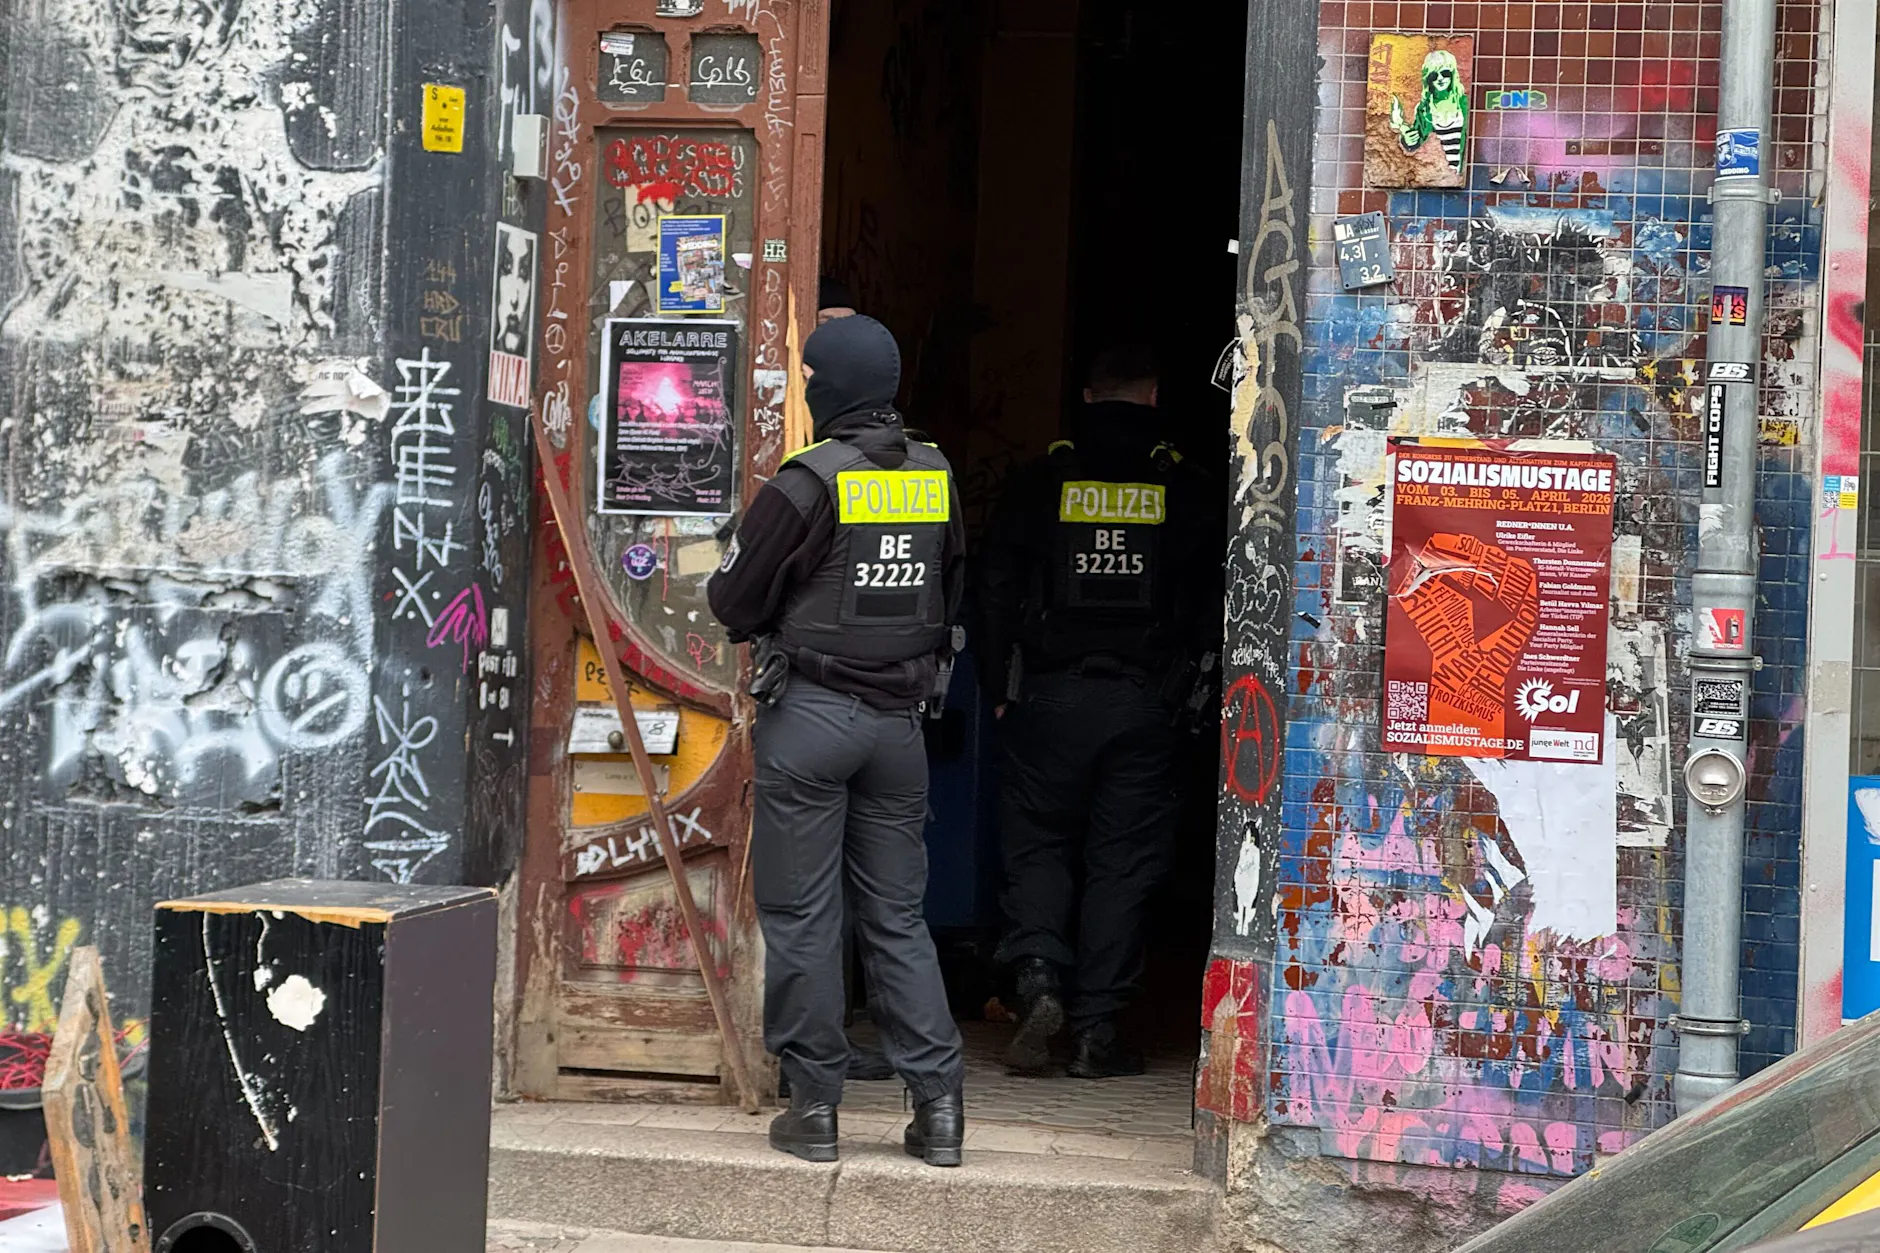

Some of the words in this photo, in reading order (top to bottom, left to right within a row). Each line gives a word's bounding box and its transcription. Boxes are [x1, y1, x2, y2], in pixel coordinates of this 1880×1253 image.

[619, 330, 727, 348] AKELARRE
[488, 351, 530, 408] NINA
[1709, 384, 1723, 433] COPS
[1412, 453, 1443, 461] KONGRESS
[1508, 458, 1552, 466] ALTERNATIVEN
[1569, 460, 1614, 468] KAPITALISMUS
[1706, 436, 1720, 486] FIGHT
[1397, 459, 1612, 492] SOZIALISMUSTAGE
[845, 479, 945, 515] POLIZEI
[1065, 486, 1161, 520] POLIZEI
[1396, 494, 1550, 512] FRANZ-MEHRING-PLATZ
[1563, 504, 1611, 515] BERLIN
[1397, 484, 1430, 496] VOM
[1440, 485, 1459, 497] 03.
[1469, 487, 1491, 499] BIS
[1501, 489, 1520, 500] 05.
[1531, 490, 1571, 502] APRIL
[1582, 492, 1611, 504] 2026
[1095, 528, 1126, 550] BE
[1558, 523, 1575, 531] U.A.
[879, 534, 913, 560] BE
[1075, 553, 1144, 574] 32215
[1532, 557, 1562, 565] Thorsten
[853, 562, 926, 587] 32222
[1500, 561, 1536, 612] ANTIFA
[1562, 583, 1596, 591] Goldmann
[1408, 597, 1462, 661] FLUCHT
[1431, 586, 1475, 649] FEMINISMUS
[1468, 592, 1538, 703] REVOLUTION
[1433, 644, 1489, 694] MARX
[1430, 684, 1495, 722] TROTZKISMUS
[1458, 683, 1504, 714] GESCHICHTE
[1529, 689, 1580, 714] Sol
[1387, 720, 1417, 732] Jetzt
[1419, 722, 1481, 736] anmelden:
[1386, 732, 1524, 751] SOZIALISMUSTAGE.DE
[1573, 736, 1595, 751] nd
